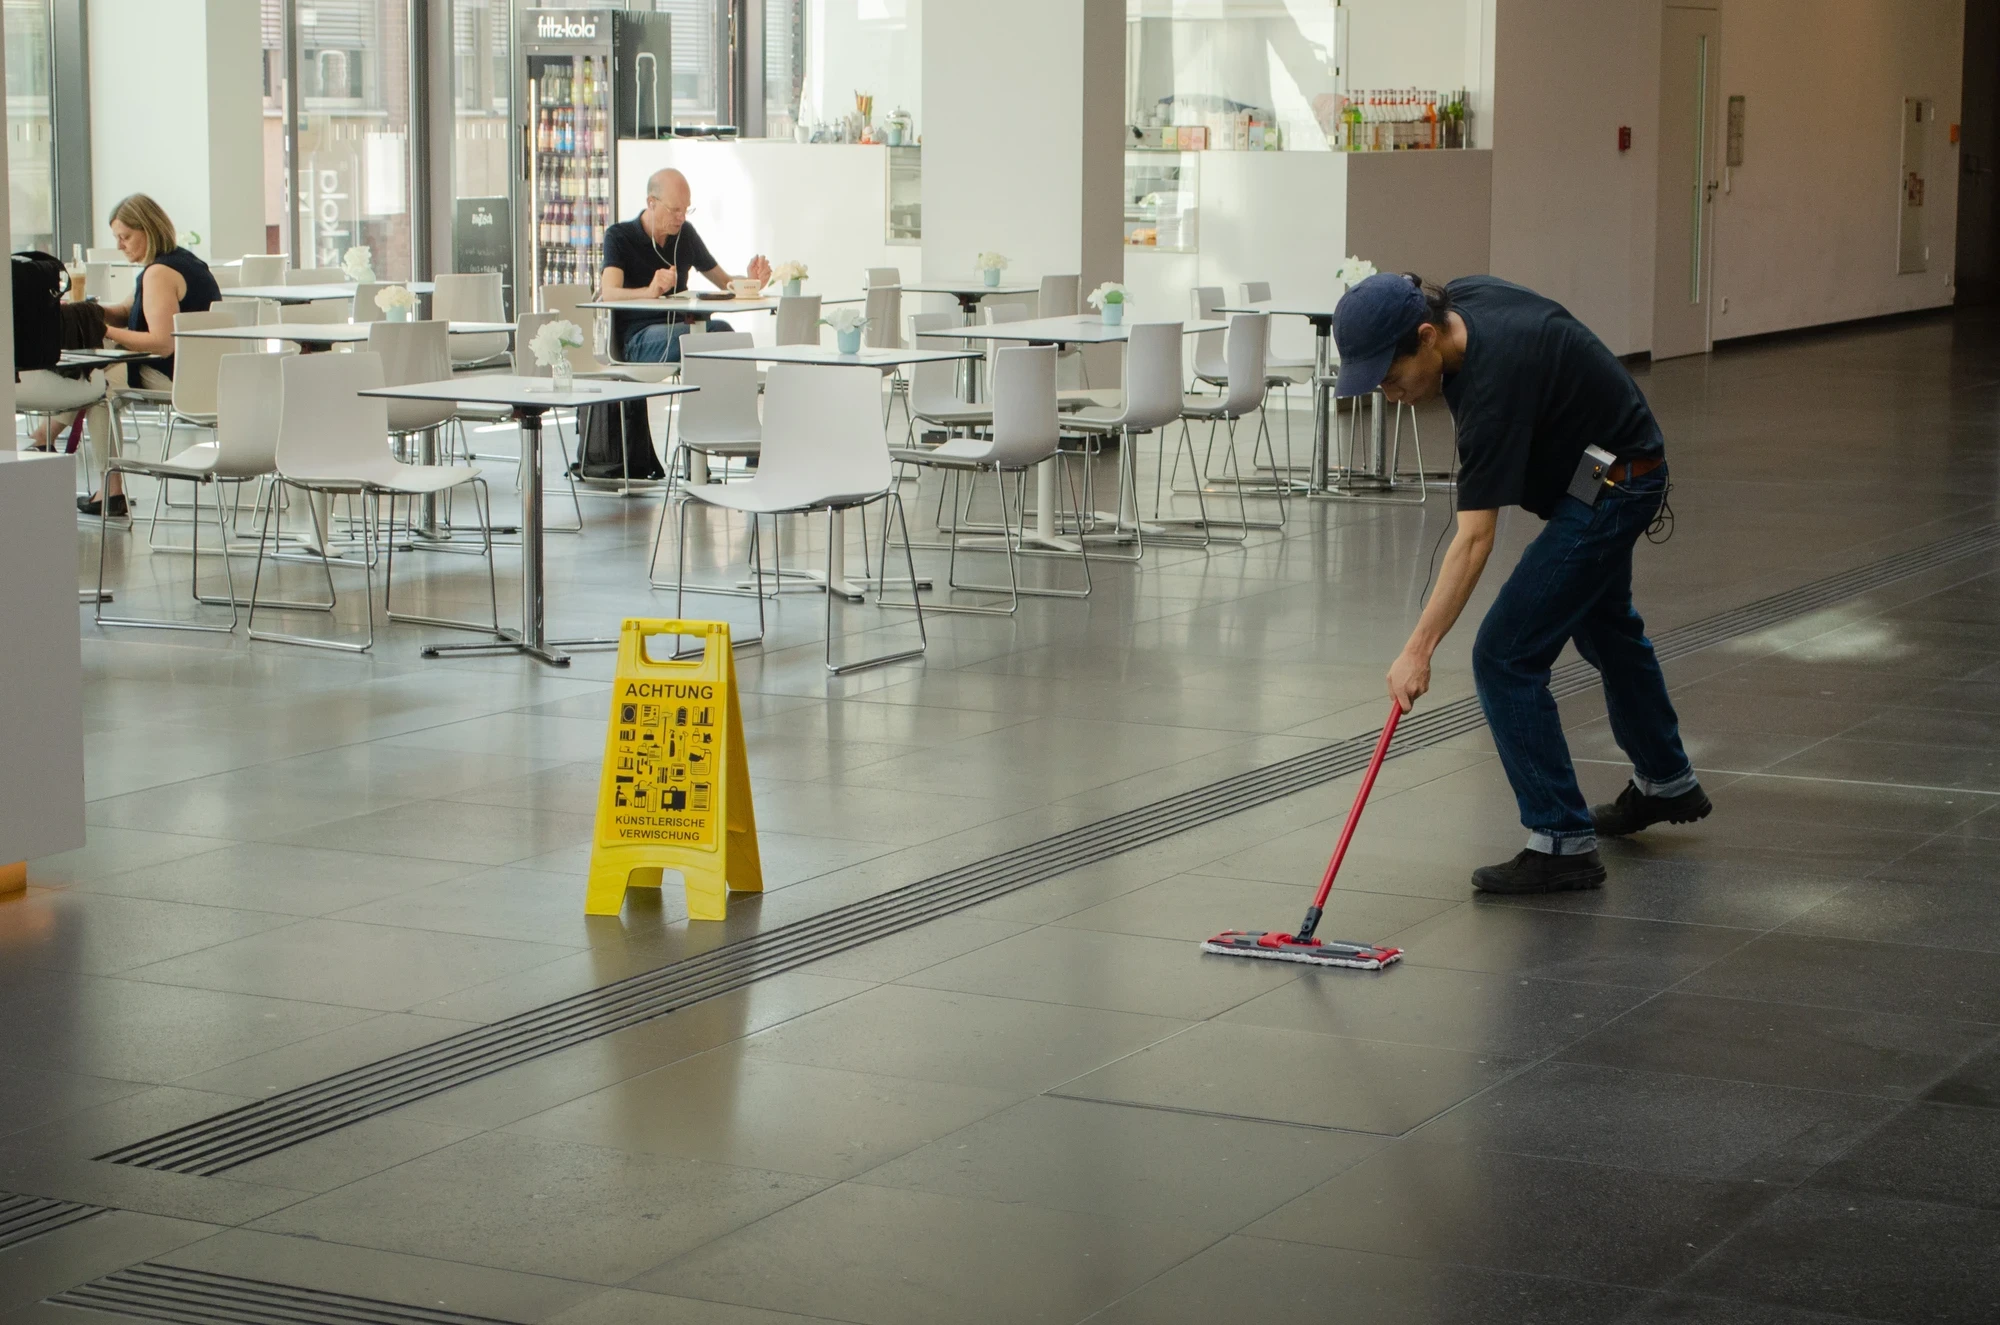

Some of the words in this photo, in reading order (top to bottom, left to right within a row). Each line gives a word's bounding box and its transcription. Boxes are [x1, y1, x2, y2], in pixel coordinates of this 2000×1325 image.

[537, 16, 596, 38] fritz-kola
[625, 683, 713, 700] ACHTUNG
[615, 814, 705, 828] KÜNSTLERISCHE
[619, 829, 700, 841] VERWISCHUNG
